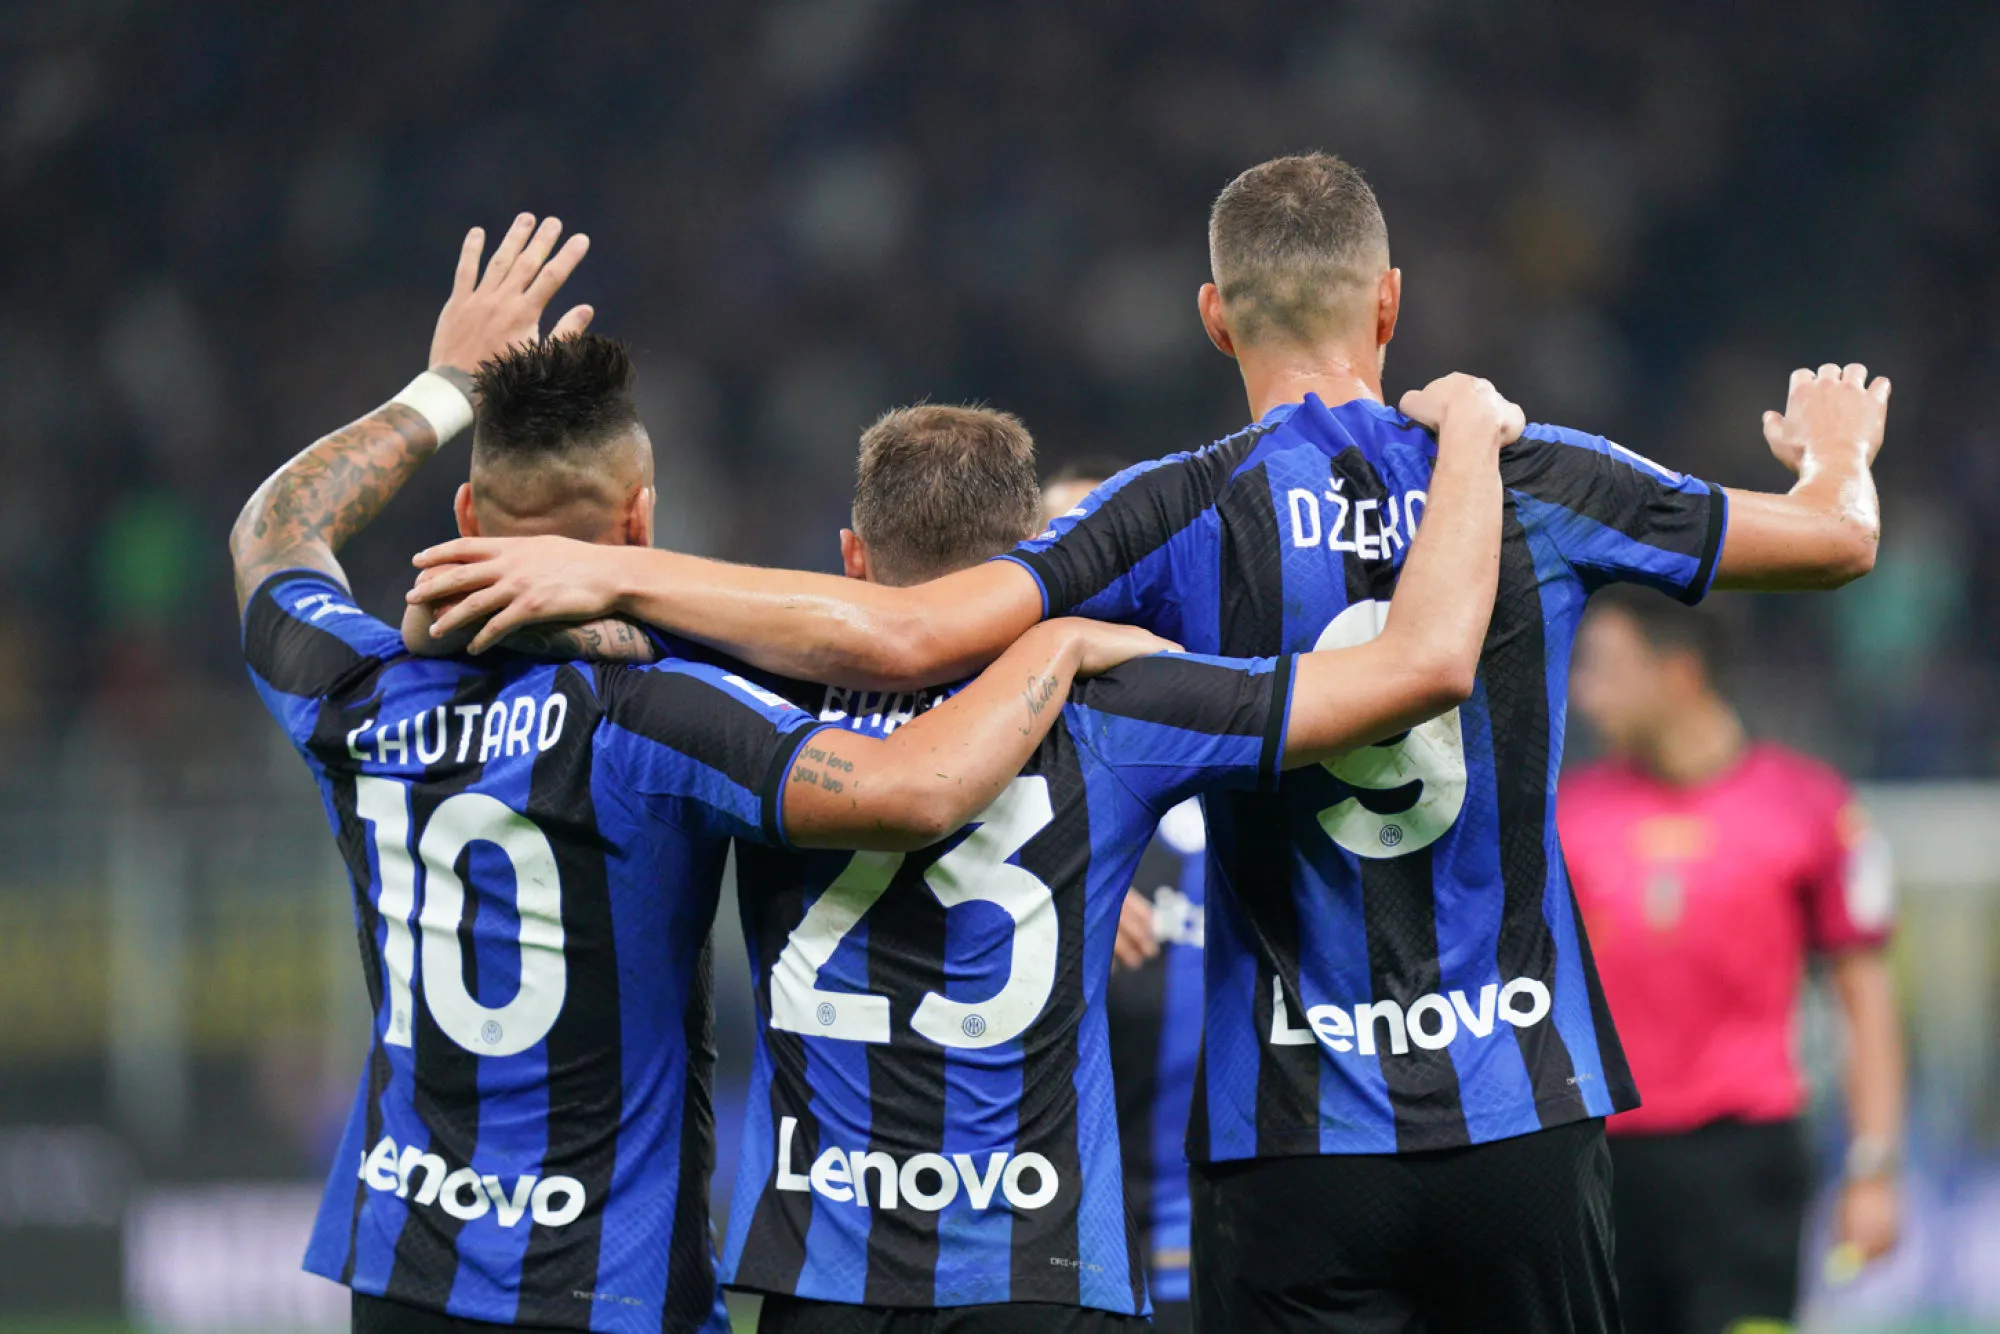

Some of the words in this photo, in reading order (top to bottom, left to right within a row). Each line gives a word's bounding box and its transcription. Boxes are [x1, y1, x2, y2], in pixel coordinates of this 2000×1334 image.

[354, 774, 568, 1058] 10
[769, 774, 1059, 1049] 23
[1270, 973, 1552, 1056] Lenovo
[358, 1135, 586, 1228] enovo
[775, 1115, 1060, 1212] Lenovo
